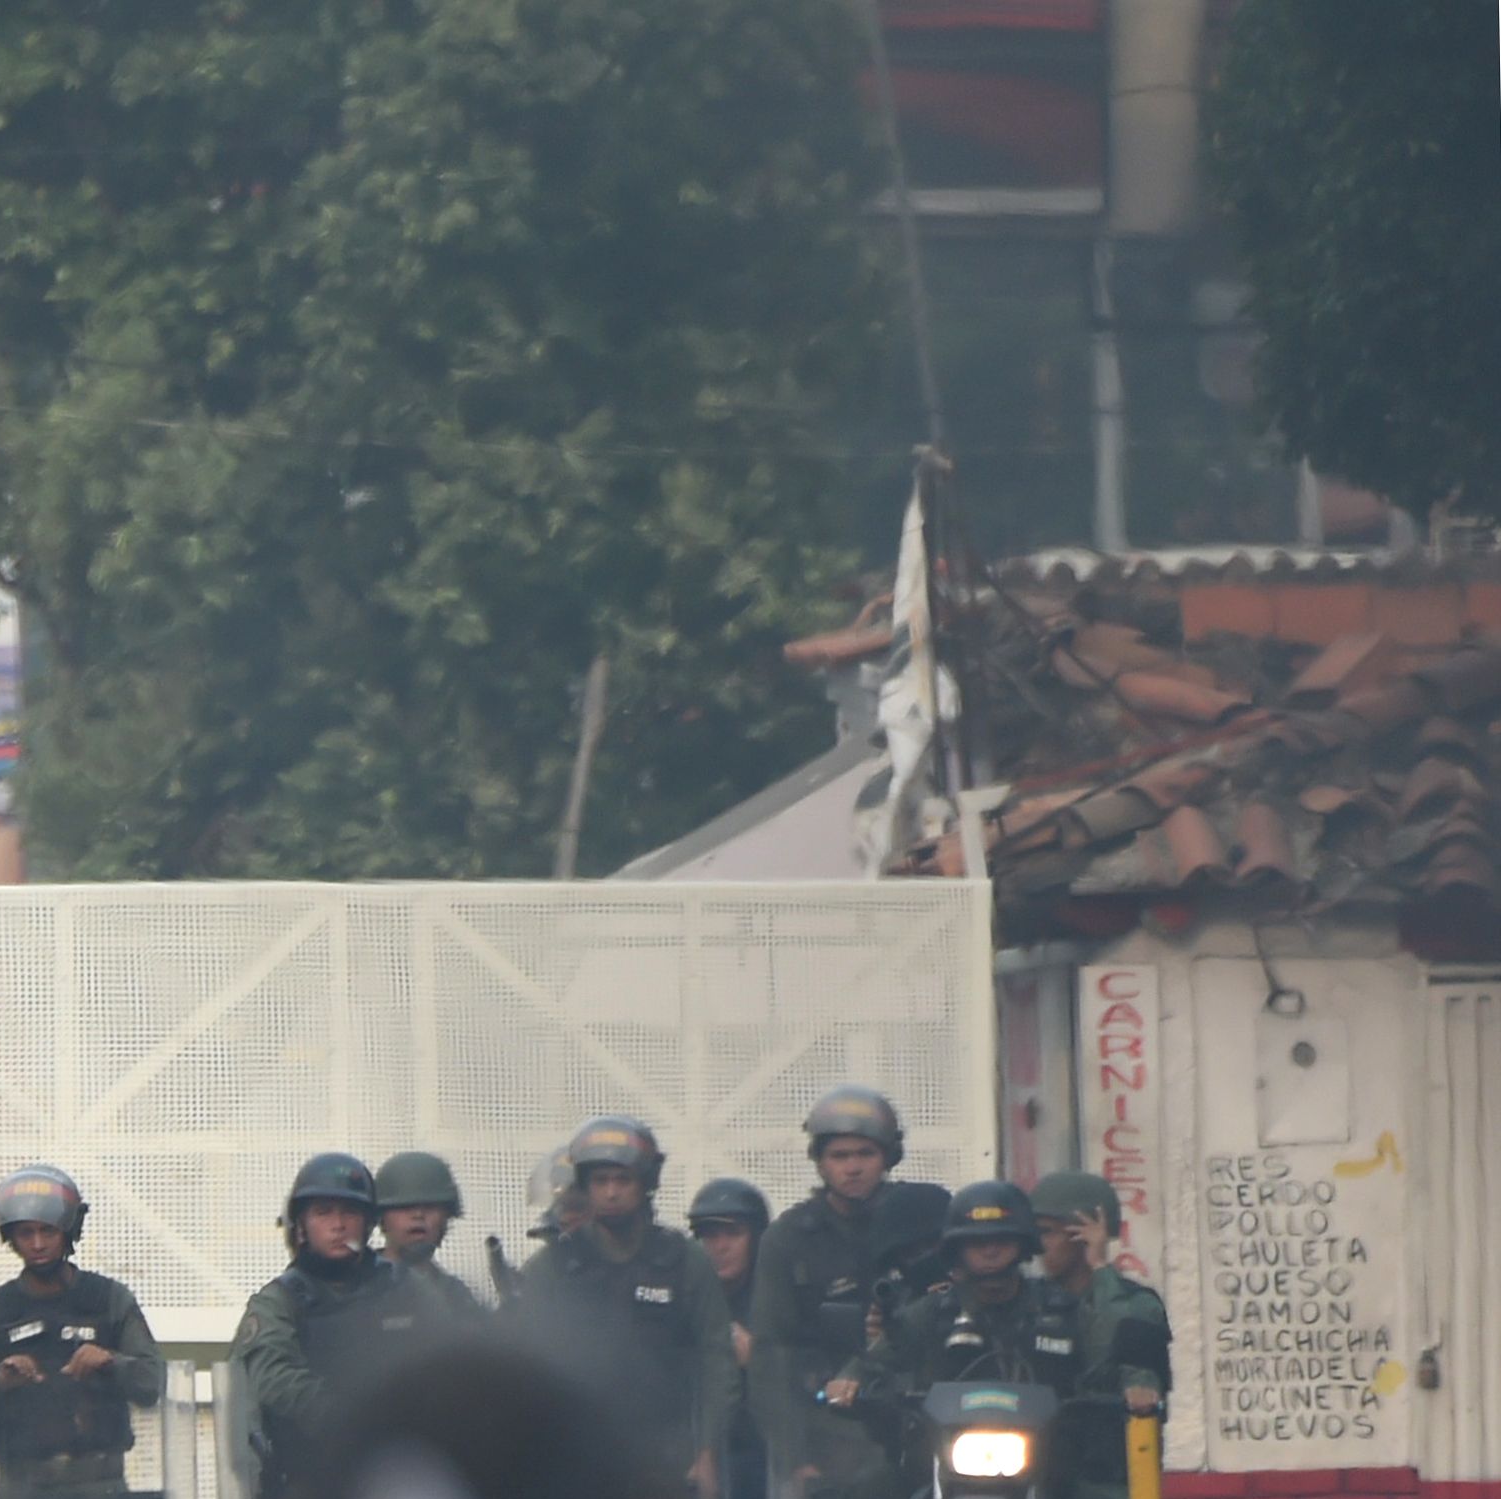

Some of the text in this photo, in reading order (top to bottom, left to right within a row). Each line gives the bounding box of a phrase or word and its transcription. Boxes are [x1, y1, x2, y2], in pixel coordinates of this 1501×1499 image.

[1208, 1156, 1290, 1181] RES
[1206, 1180, 1335, 1207] CERDO
[1208, 1209, 1329, 1235] POLLO
[1212, 1237, 1368, 1266] CHULETA
[1214, 1268, 1352, 1297] QUESO
[1218, 1301, 1352, 1325] JAMON
[1216, 1325, 1390, 1352] SALCHICHA
[1219, 1384, 1380, 1411] TOCINETA
[1219, 1414, 1375, 1440] HUEVOS
